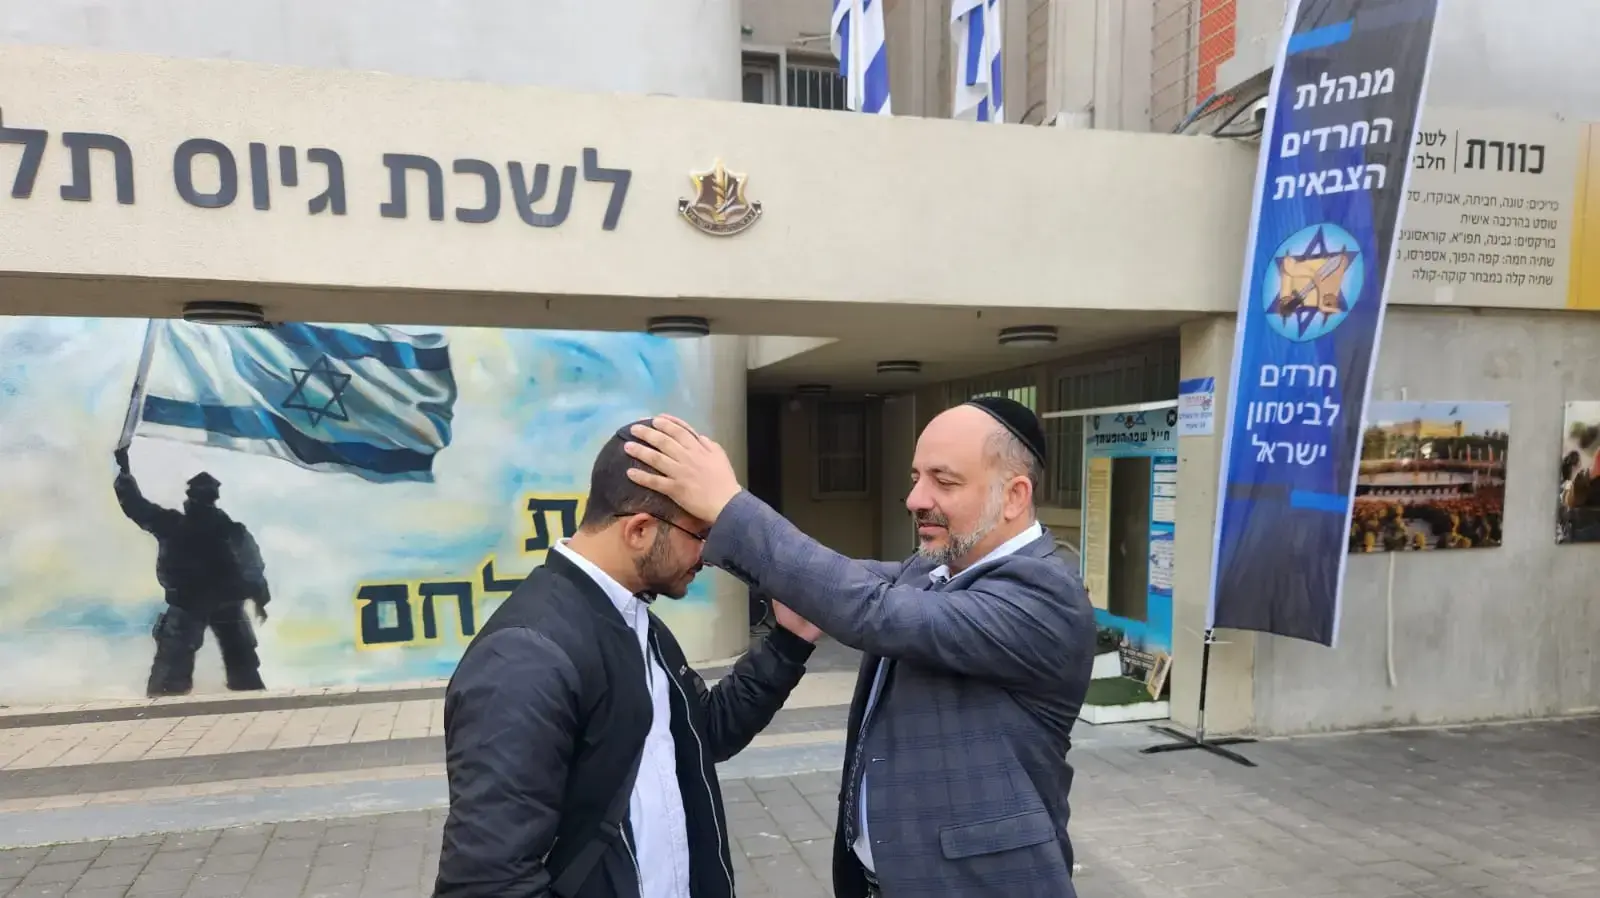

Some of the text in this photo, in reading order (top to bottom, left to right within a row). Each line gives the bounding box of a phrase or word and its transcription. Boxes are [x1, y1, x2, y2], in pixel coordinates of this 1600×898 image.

[1293, 67, 1395, 110] מנהלת
[1280, 117, 1394, 158] החרדים
[1464, 137, 1546, 174] כוורת
[0, 106, 632, 231] לשכת גיוס תל
[1272, 163, 1387, 200] הצבאית
[1423, 191, 1461, 205] אבוקדו,
[1463, 194, 1497, 207] חביתה,
[1500, 197, 1524, 208] טונה,
[1460, 213, 1490, 225] אישית
[1533, 218, 1557, 229] טוסט
[1484, 234, 1512, 246] גבינה,
[1403, 249, 1447, 262] אספרסו,
[1449, 252, 1476, 264] הפוך,
[1478, 253, 1500, 266] קפה
[1502, 255, 1527, 265] חמה:
[1530, 256, 1555, 267] שתיה
[1412, 267, 1467, 284] קוקה-קולה
[1505, 271, 1526, 286] קלה
[1529, 274, 1554, 285] שתיה
[1260, 364, 1338, 388] חרדים
[1246, 396, 1340, 430] לביטחון
[1151, 428, 1170, 441] חייל
[1252, 433, 1328, 466] ישראל
